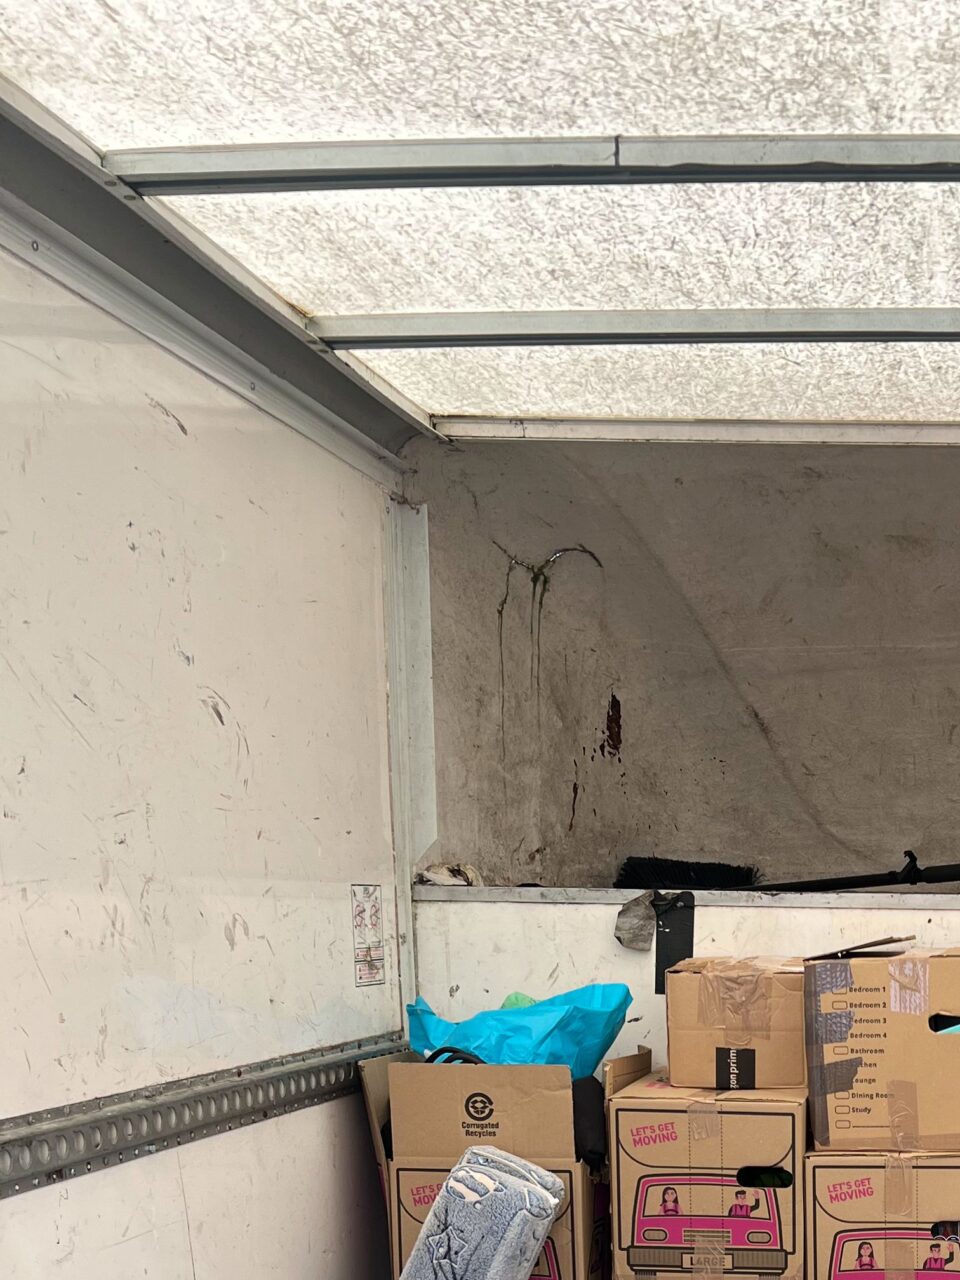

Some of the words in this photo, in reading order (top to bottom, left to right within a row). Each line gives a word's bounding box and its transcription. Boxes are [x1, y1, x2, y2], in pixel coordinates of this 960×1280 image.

[851, 1092, 874, 1100] Dining
[851, 1106, 872, 1114] Study
[461, 1122, 500, 1130] Corrugated
[630, 1124, 656, 1137] LET'S
[658, 1121, 676, 1133] GET
[465, 1129, 497, 1138] Recycles
[632, 1131, 678, 1148] MOVING
[410, 1184, 435, 1196] LET'S
[826, 1181, 853, 1193] LET'S
[854, 1177, 872, 1188] GET
[412, 1193, 436, 1207] MOV
[828, 1186, 874, 1204] MOVING
